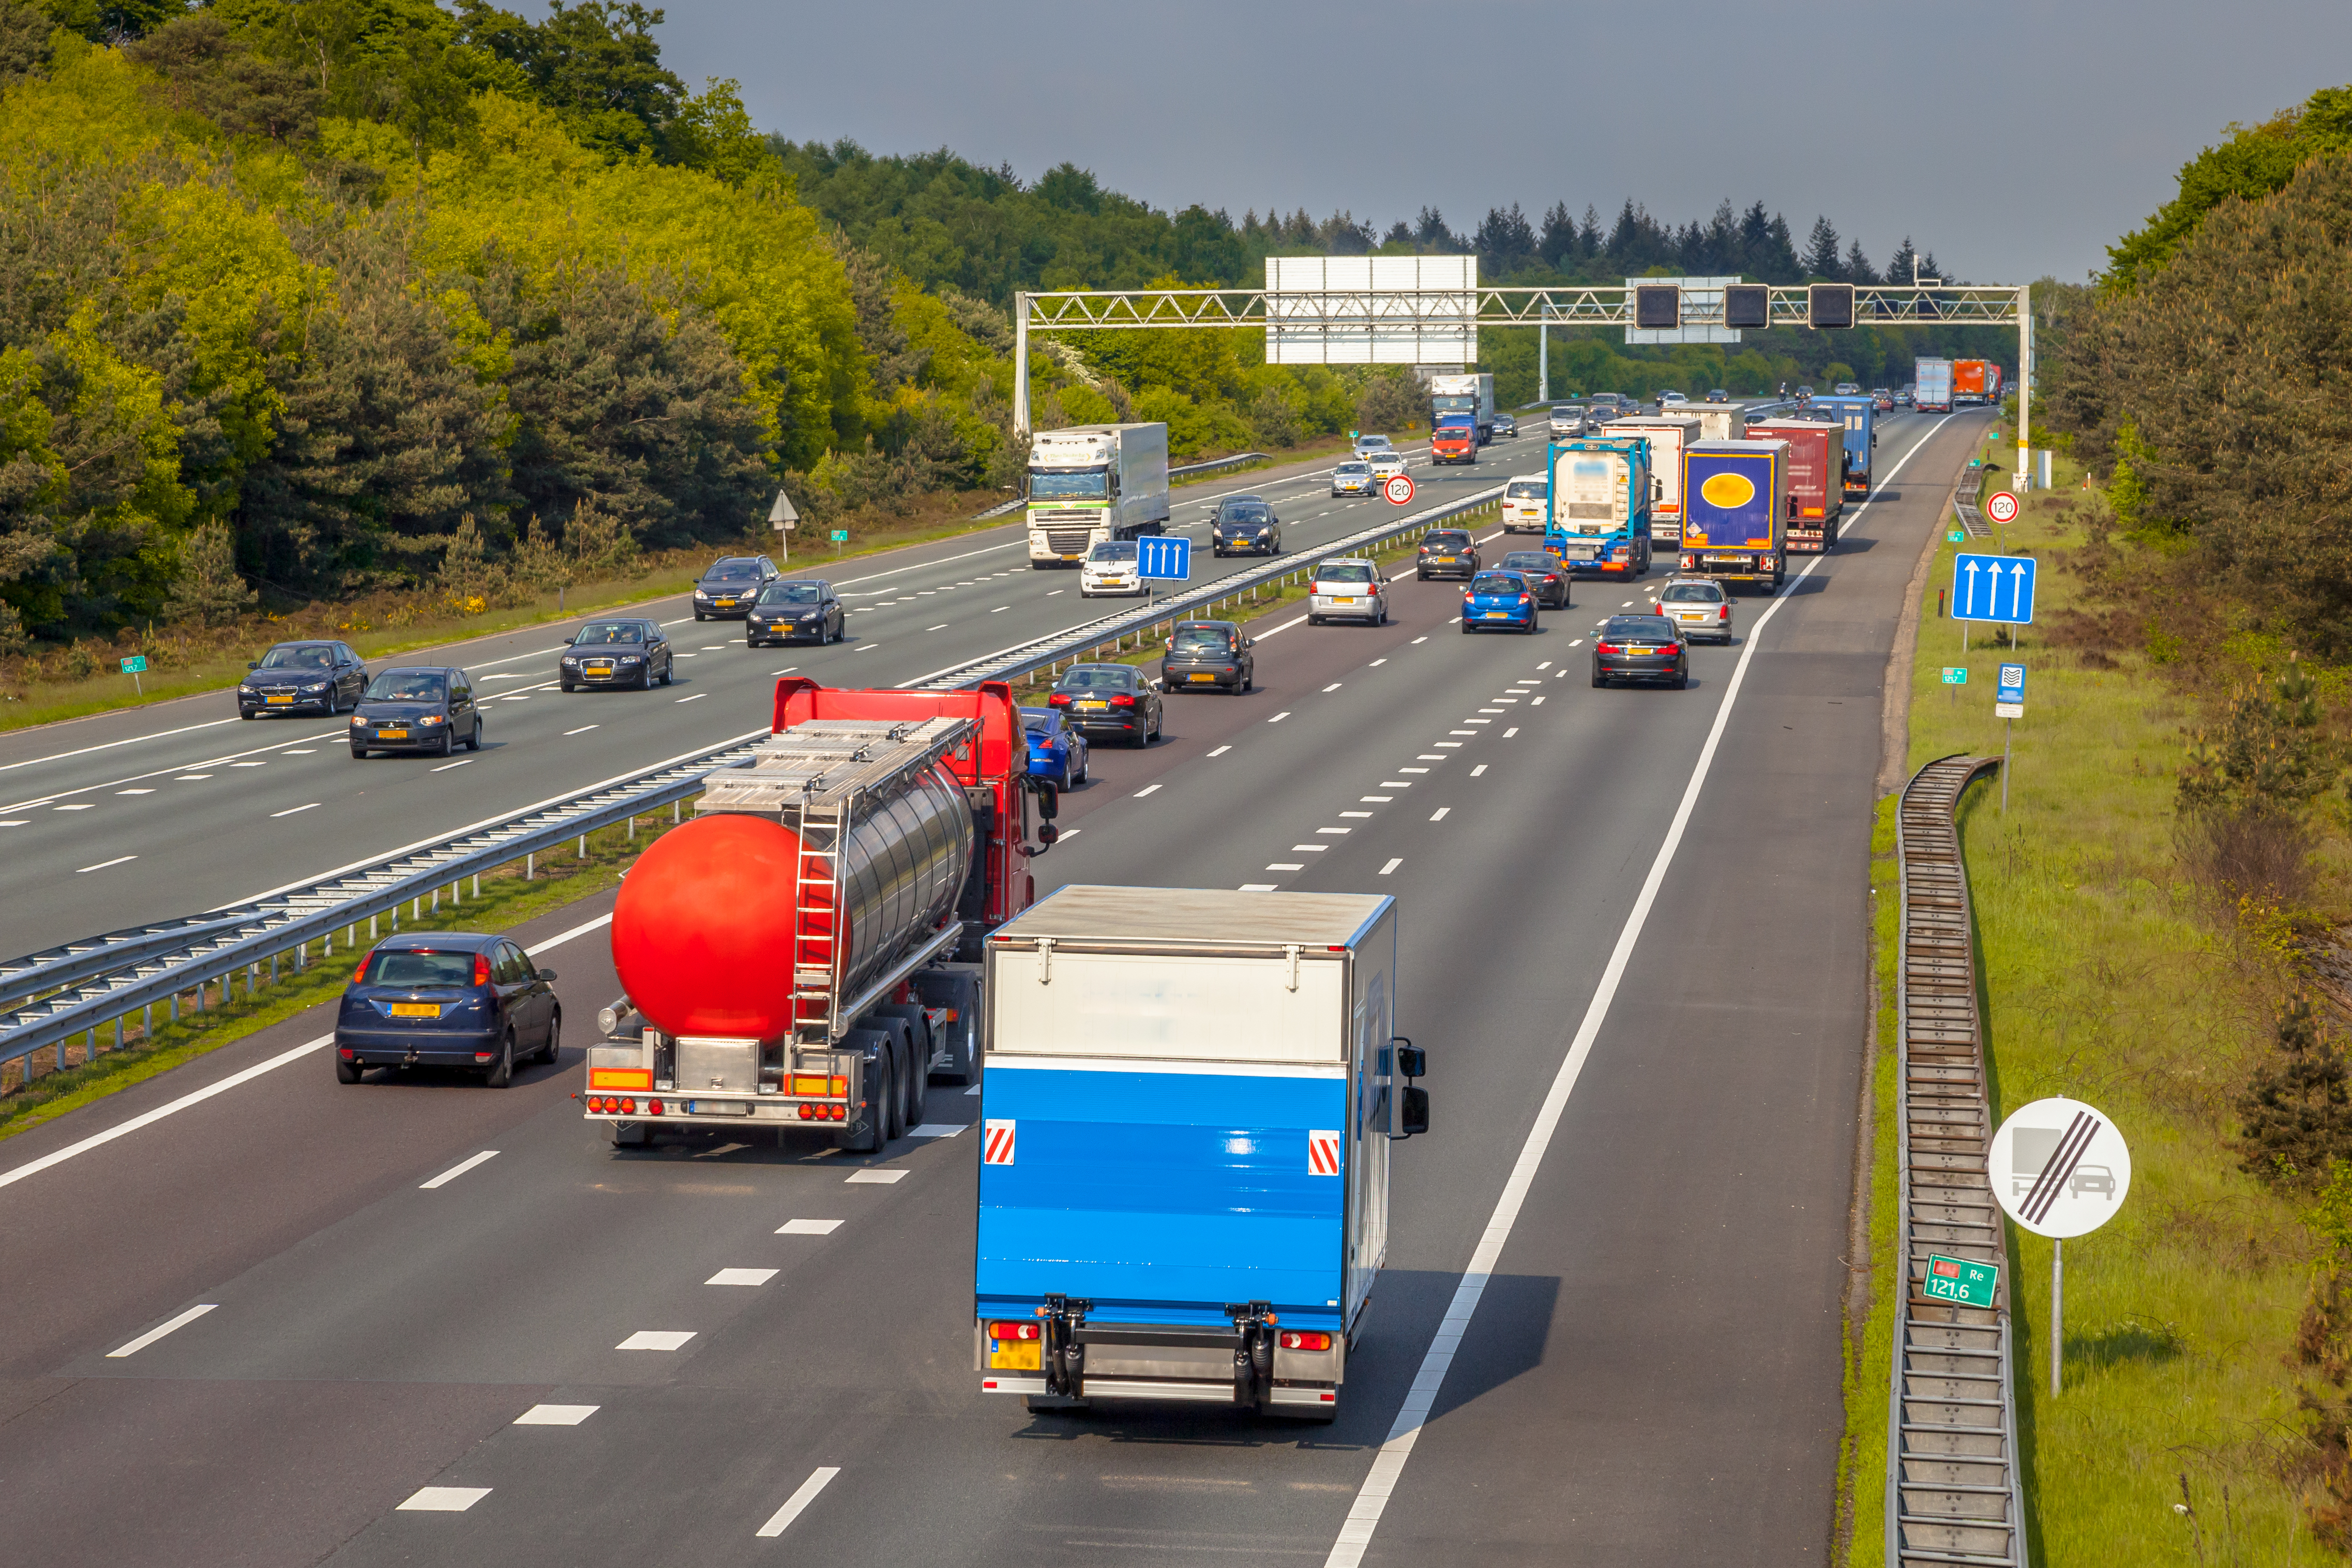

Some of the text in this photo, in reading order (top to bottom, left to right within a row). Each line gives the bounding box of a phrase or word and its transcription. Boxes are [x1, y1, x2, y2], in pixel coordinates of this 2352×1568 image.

[1391, 484, 1409, 495] 120
[1994, 502, 2013, 513] 120
[1969, 1269, 1984, 1281] Re
[1931, 1278, 1970, 1299] 121,6
